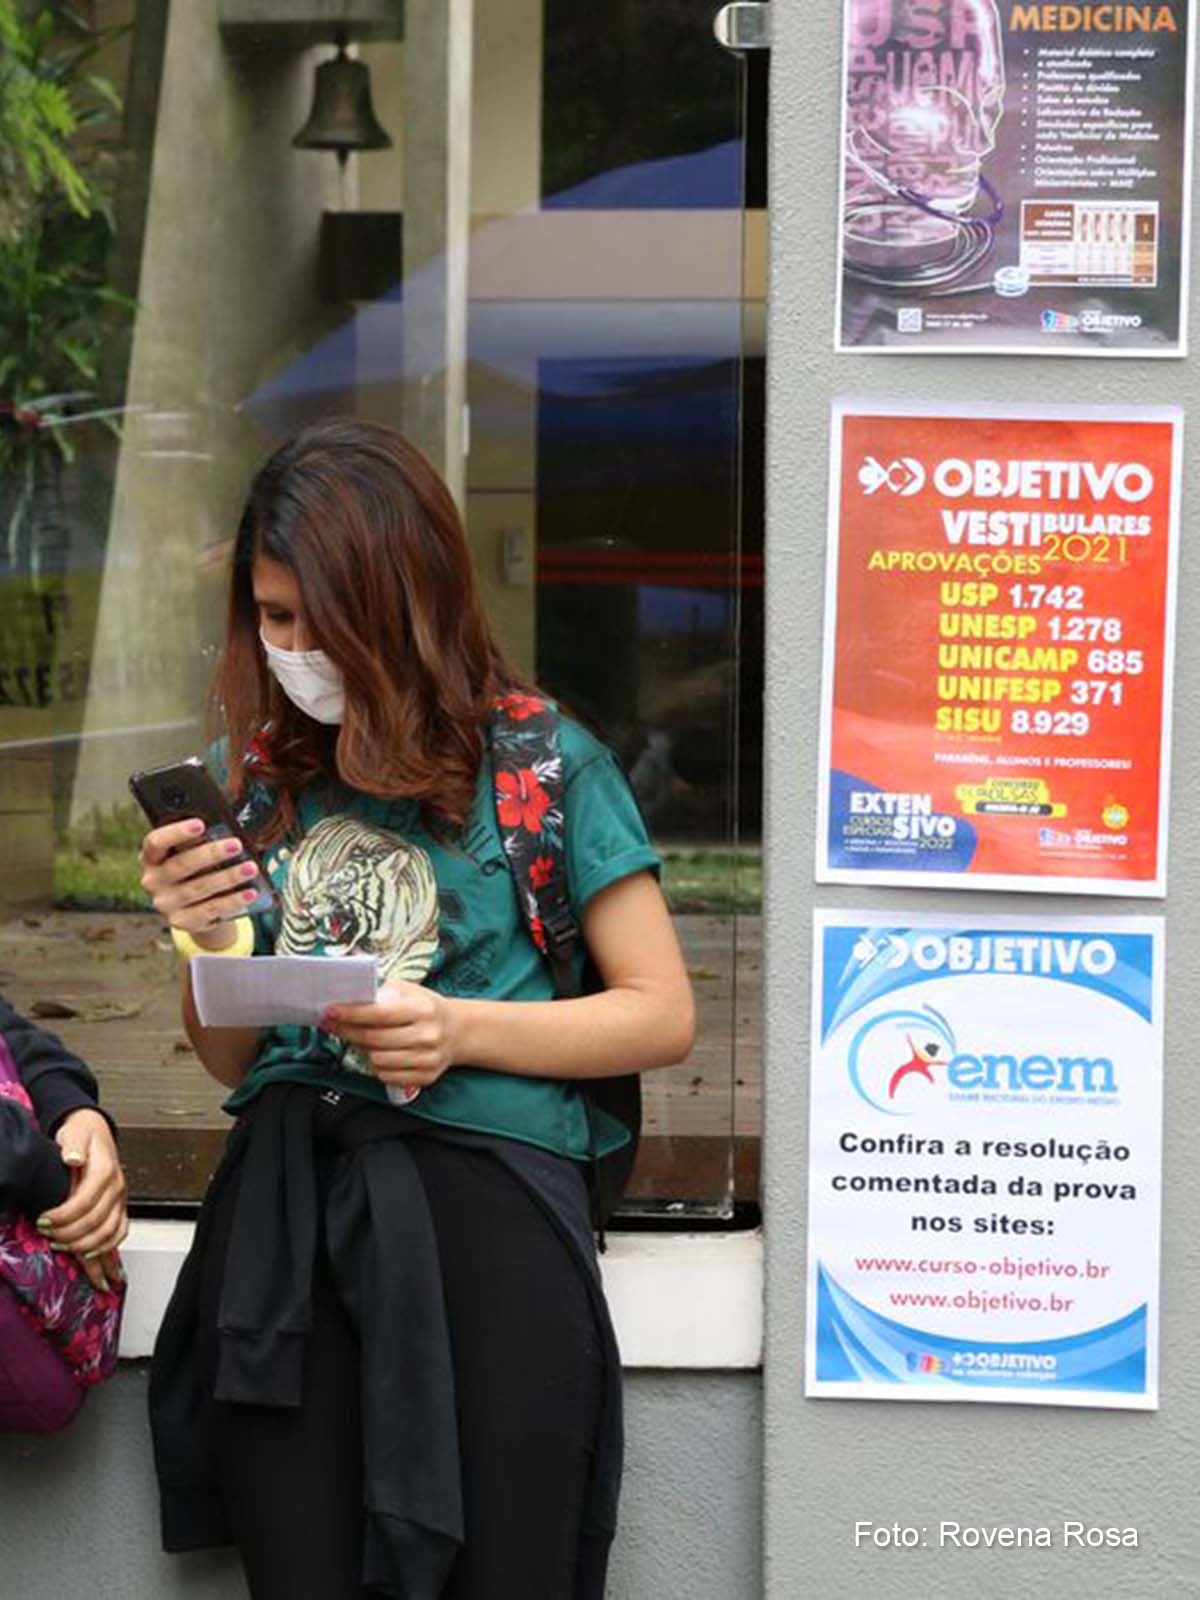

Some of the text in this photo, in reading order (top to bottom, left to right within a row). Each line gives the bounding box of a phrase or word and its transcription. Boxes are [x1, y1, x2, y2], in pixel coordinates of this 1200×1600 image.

[1008, 4, 1178, 33] MEDICINA
[933, 457, 1153, 501] OBJETIVO
[1042, 534, 1128, 563] 2021
[867, 549, 1042, 578] APROVAÇÕES
[940, 581, 1084, 610] USP 1.742
[938, 612, 1122, 642] UNESP 1.278
[938, 644, 1144, 675] UNICAMP 685
[936, 675, 1123, 706] UNIFESP 371
[935, 706, 1090, 737] SISU 8.929
[849, 791, 932, 816] EXTEN
[892, 815, 957, 840] SIVO
[912, 937, 1117, 976] OBJETIVO
[947, 1049, 1118, 1094] enem
[838, 1132, 1131, 1166] Confira a resolução
[830, 1172, 1137, 1203] comentada da prova
[911, 1212, 1055, 1237] nos sites:
[855, 1255, 1110, 1281] www.curso-objetivo.br
[889, 1290, 1075, 1314] www.objetivo.br
